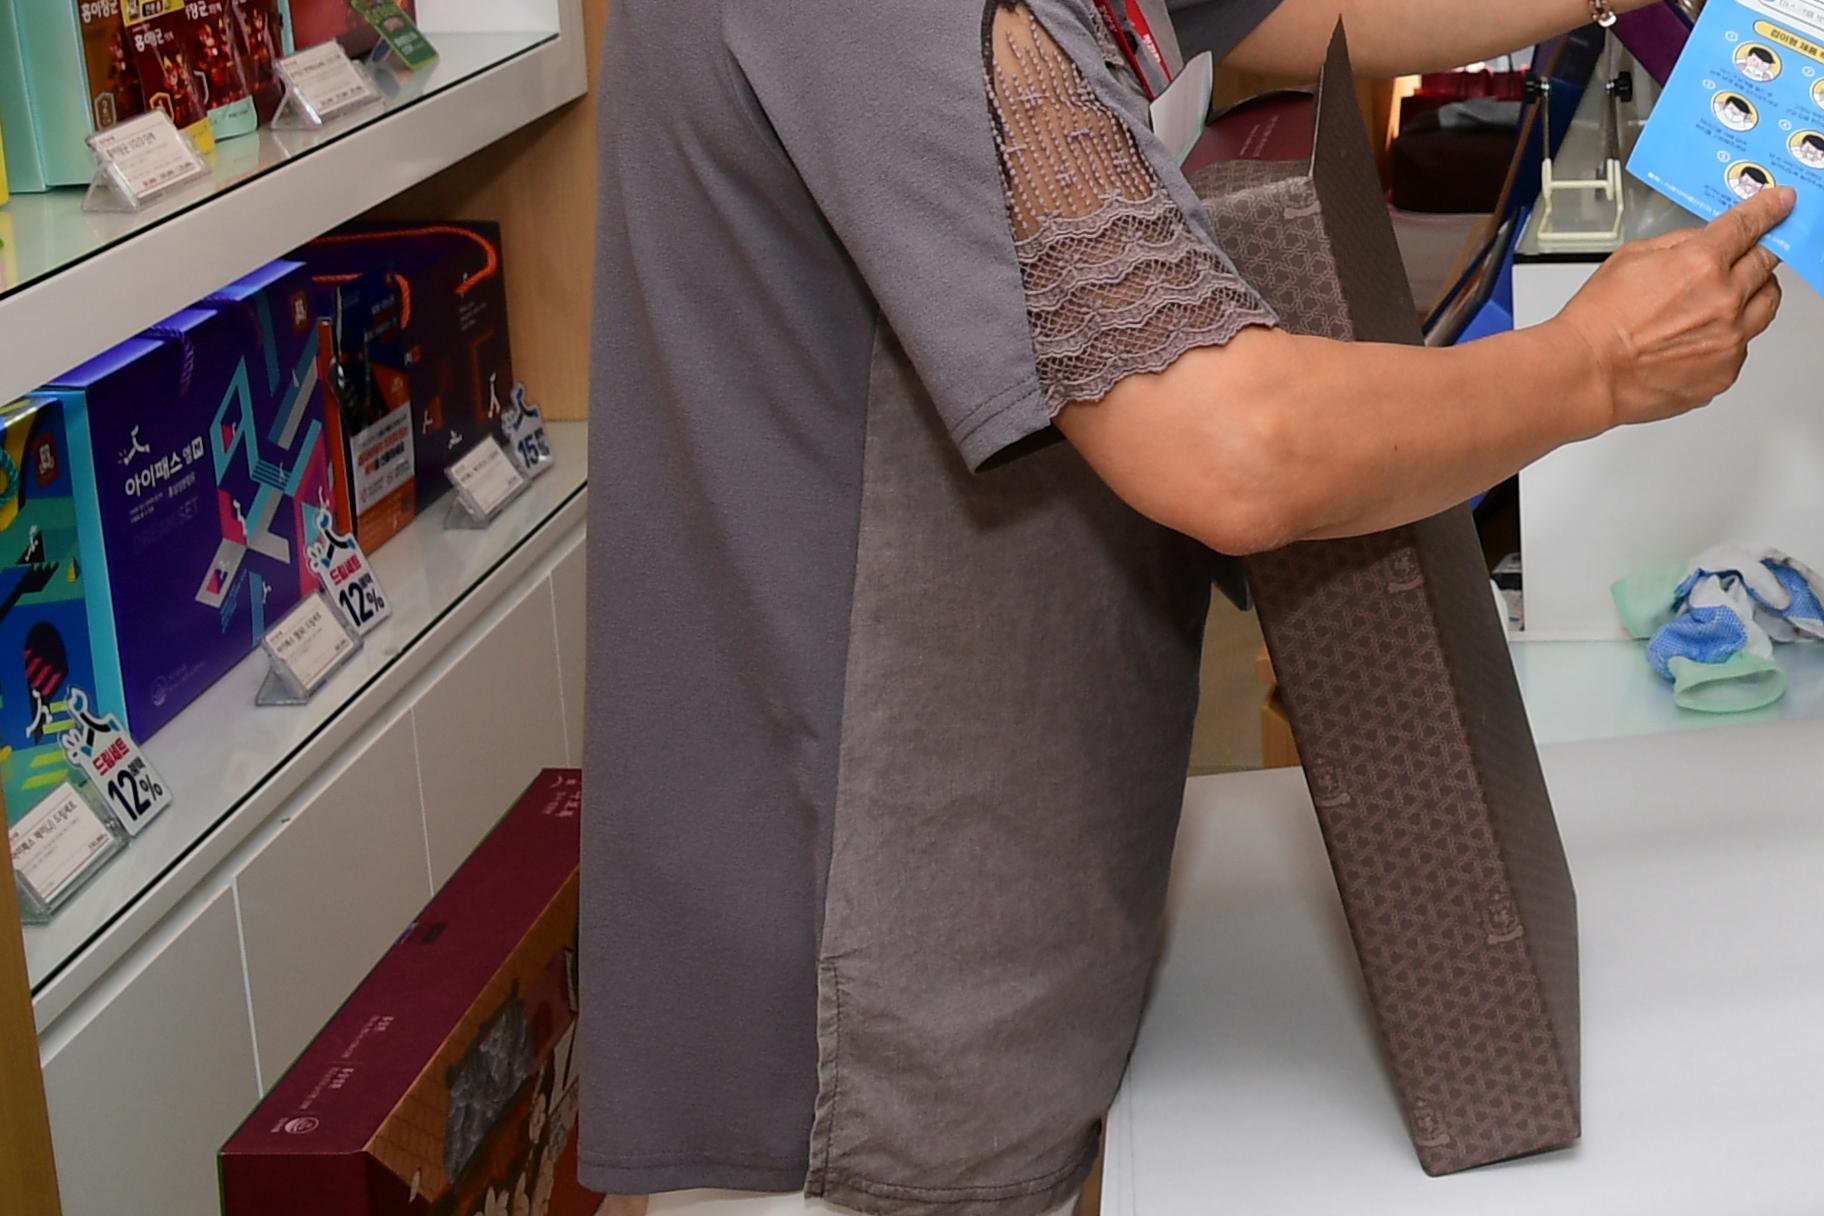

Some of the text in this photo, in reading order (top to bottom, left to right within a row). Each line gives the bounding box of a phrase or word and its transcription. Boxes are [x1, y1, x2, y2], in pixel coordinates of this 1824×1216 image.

[1770, 28, 1799, 46] 접이형
[1799, 41, 1819, 58] 제품
[125, 451, 183, 497] 아이패스
[339, 582, 385, 627] 12%
[92, 737, 130, 776] 드림세트
[107, 769, 163, 821] 12%
